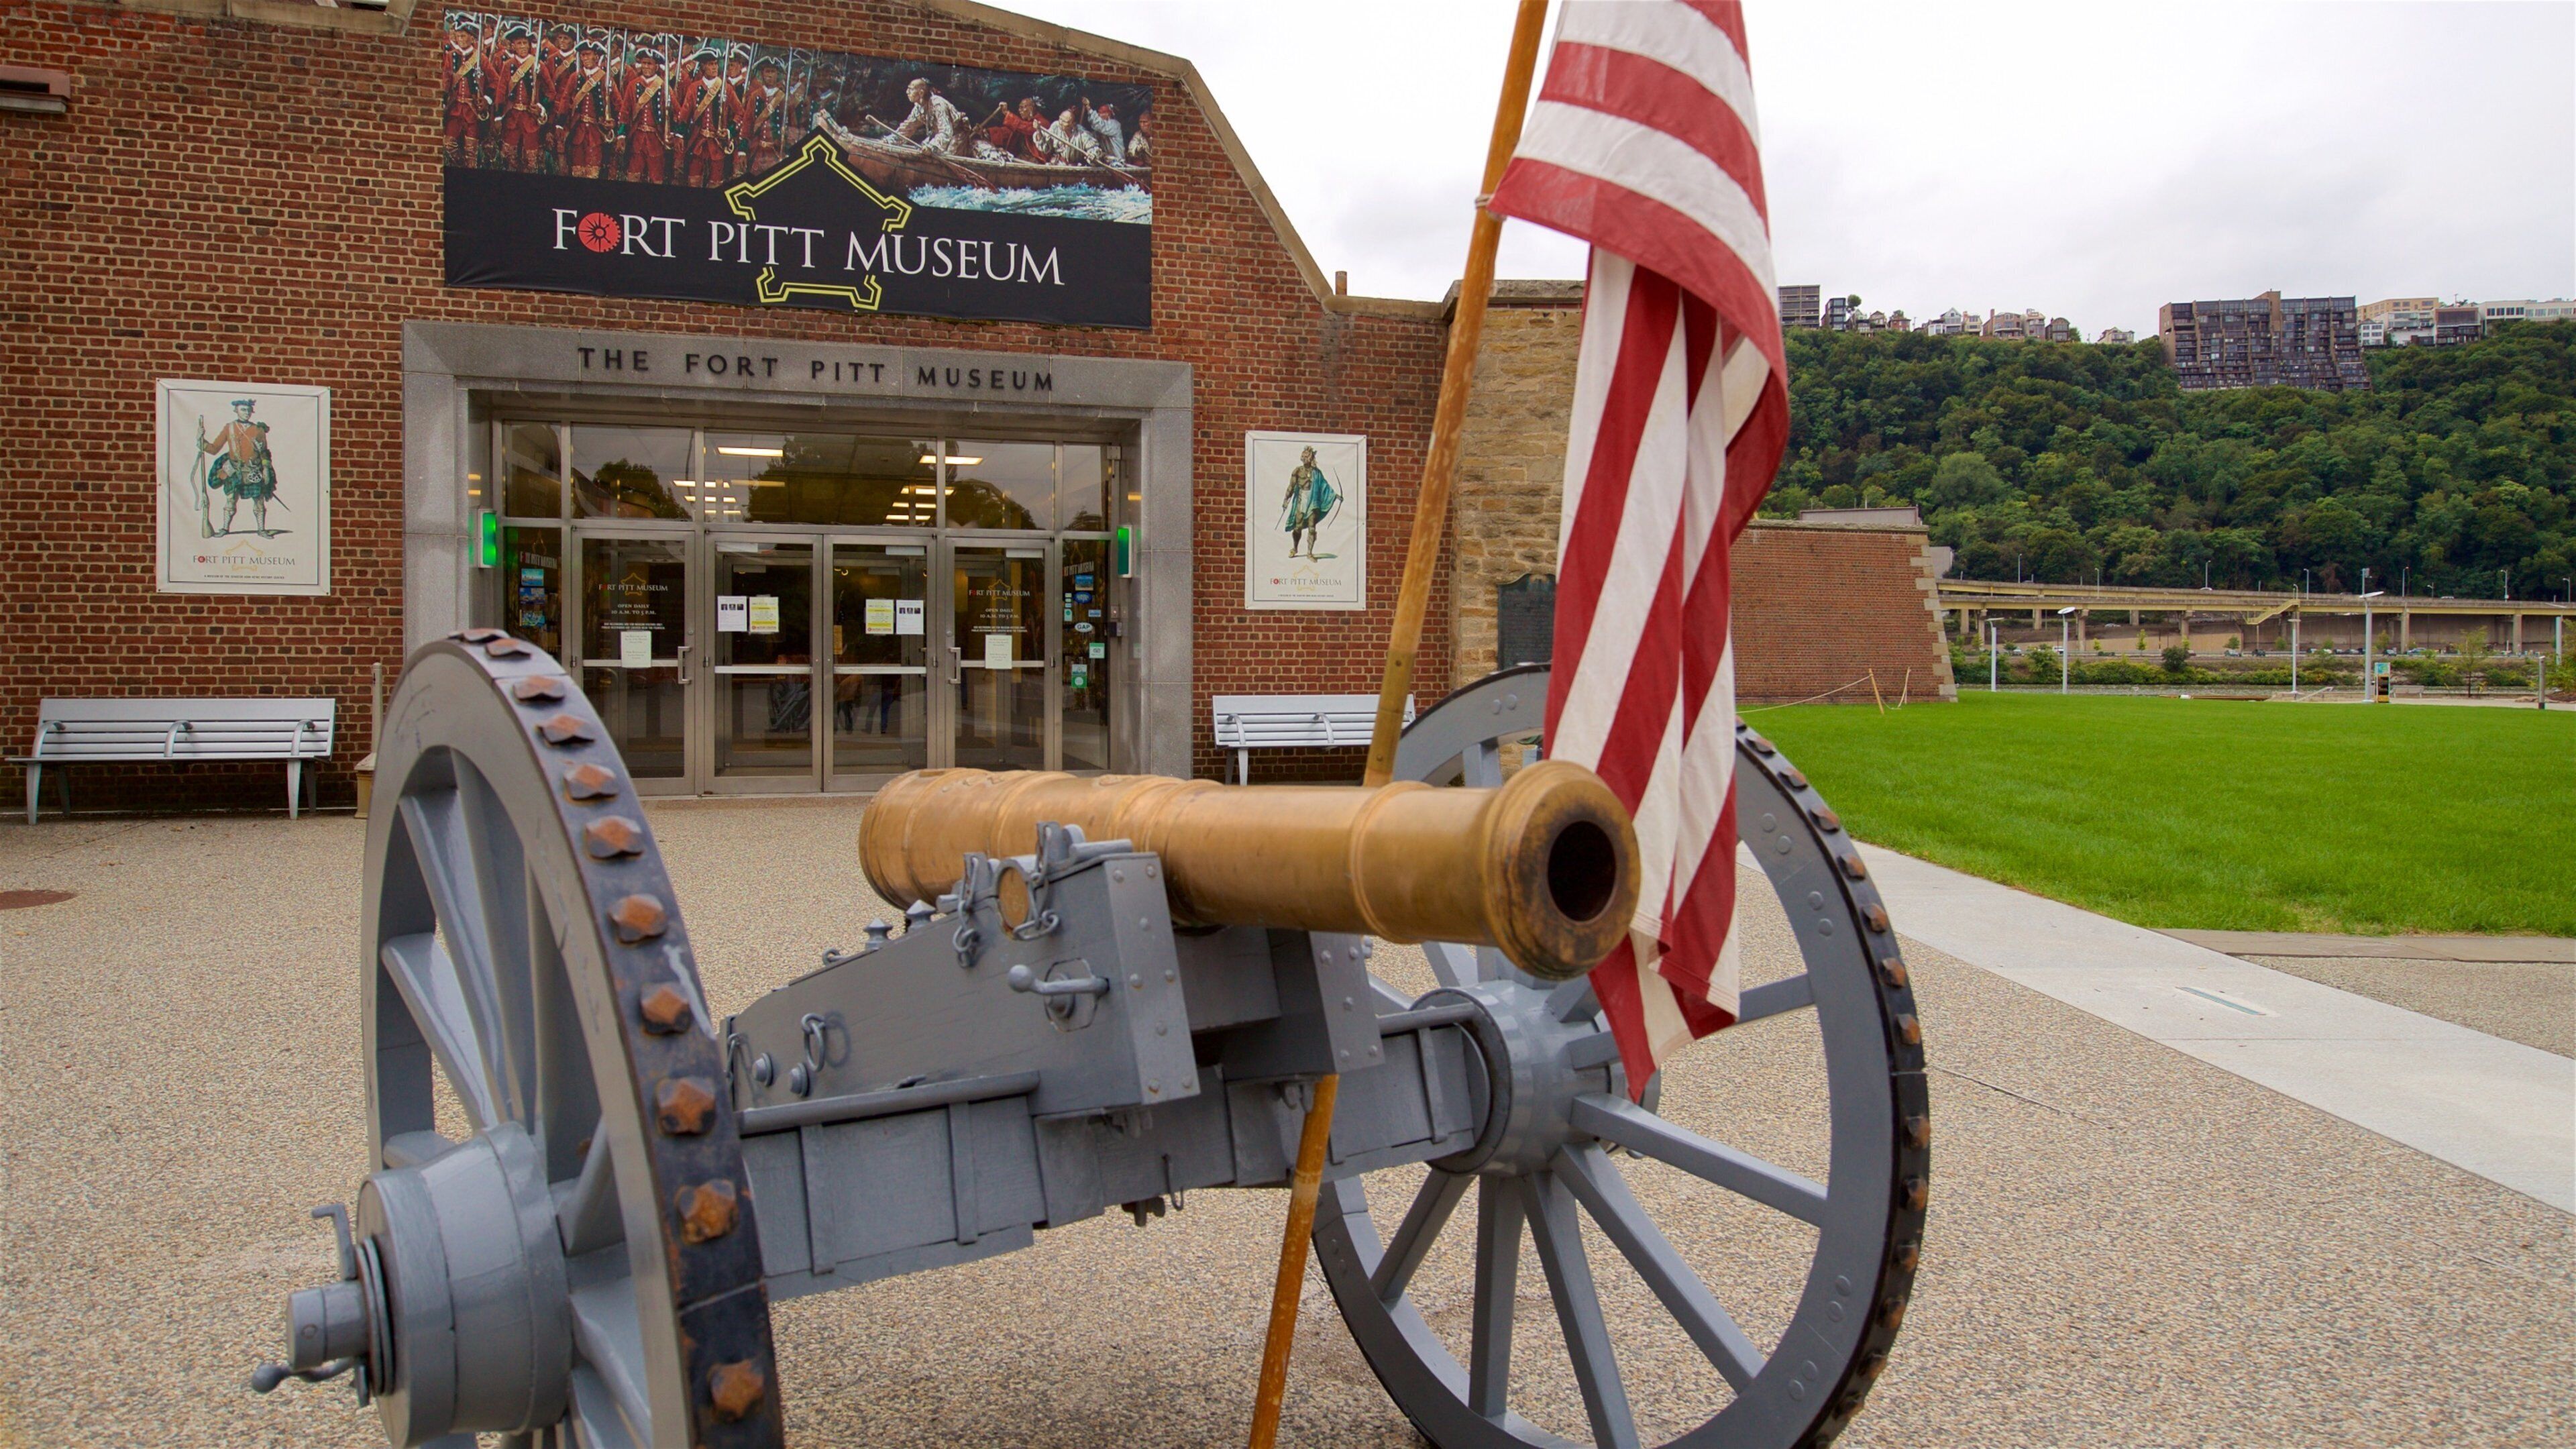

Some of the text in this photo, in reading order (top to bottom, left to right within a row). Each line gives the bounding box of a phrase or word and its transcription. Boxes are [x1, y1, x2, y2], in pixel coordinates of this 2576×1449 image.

[552, 209, 1065, 285] FORT PITT MUSEUM
[578, 347, 1053, 391] THE FORT PITT MUSEUM
[193, 555, 296, 565] FORT PITT MUSEUM
